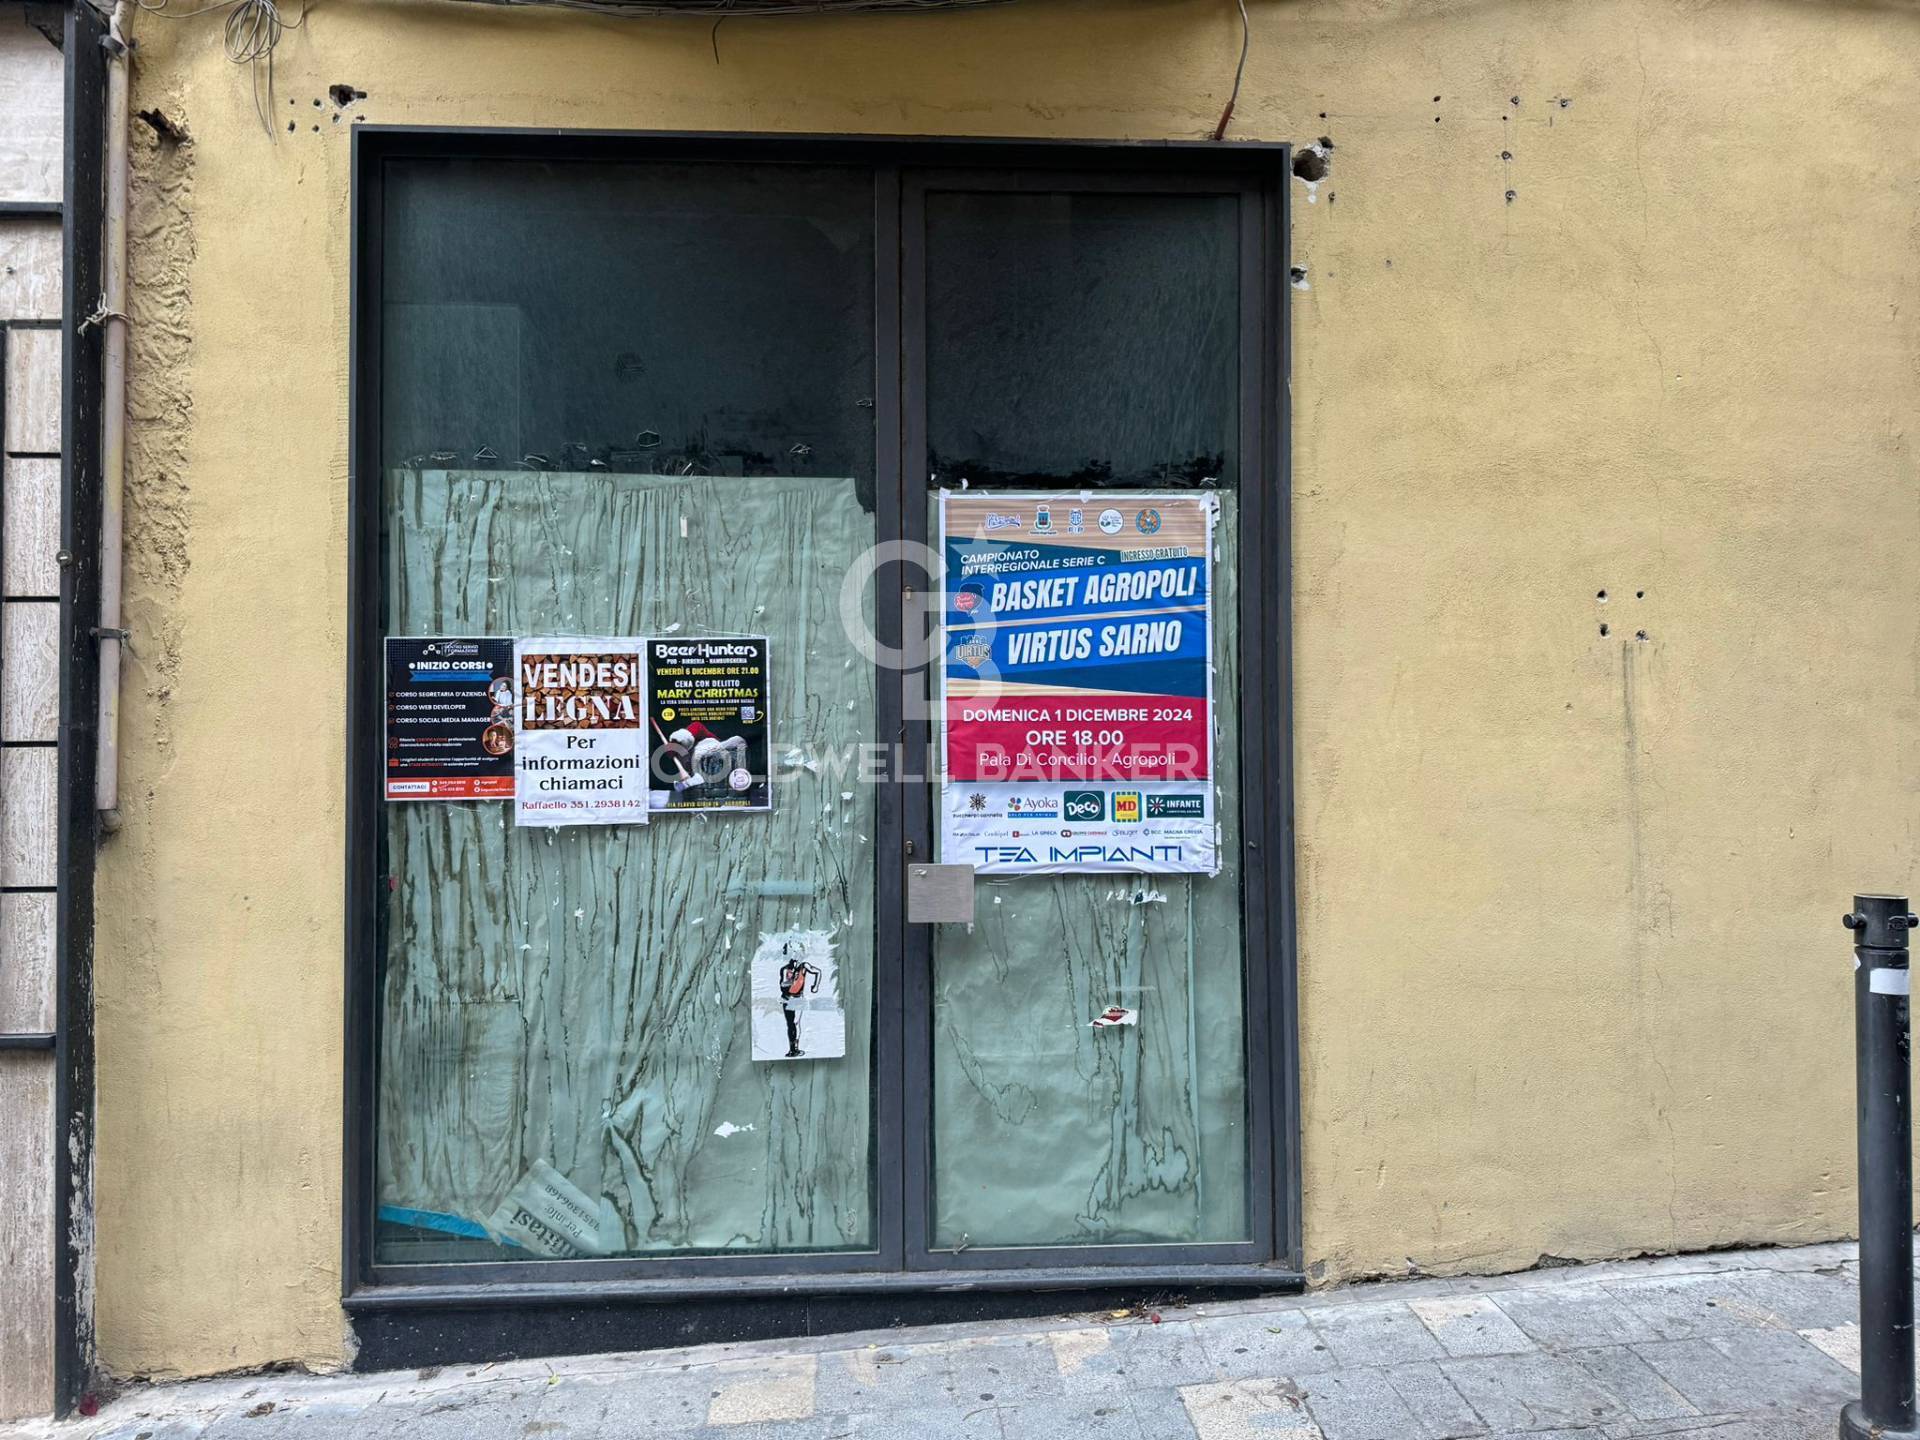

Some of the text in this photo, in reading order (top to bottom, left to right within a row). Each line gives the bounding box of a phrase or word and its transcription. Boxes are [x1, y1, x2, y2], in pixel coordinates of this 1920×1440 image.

[960, 549, 1040, 565] CAMPIONATO
[1120, 546, 1189, 563] INGRESSO GRATUITO
[961, 555, 1106, 576] INTERREGIONALE SERIE C
[990, 566, 1198, 613] BASKET AGROPOLI
[1008, 620, 1182, 665] VIRTUS SARNO
[656, 643, 758, 658] Beer Hunters
[417, 661, 485, 670] INIZIO CORSI
[656, 666, 684, 676] VENERDÌ
[692, 667, 725, 675] DICEMBRE
[523, 662, 637, 689] VENDESI
[675, 680, 693, 688] CENA
[657, 688, 758, 698] MARY CHRISTMAS
[524, 695, 636, 723] LEGNA
[963, 708, 1192, 722] DOMENICA 1 DICEMBRE 2024
[566, 736, 597, 749] Per
[1026, 730, 1124, 746] ORE 18.00
[522, 755, 640, 770] informazioni
[979, 753, 1011, 766] Pala
[1016, 753, 1032, 766] Di
[1036, 752, 1097, 766] Concilio
[1112, 752, 1176, 768] Agropoli
[539, 776, 623, 791] chiamaci
[522, 799, 640, 810] Raffaello 351.2938142
[1023, 797, 1058, 811] Ayoka
[1117, 801, 1137, 811] MD
[1166, 800, 1201, 808] INFANTE
[975, 846, 1182, 862] TEA IMPIANTI
